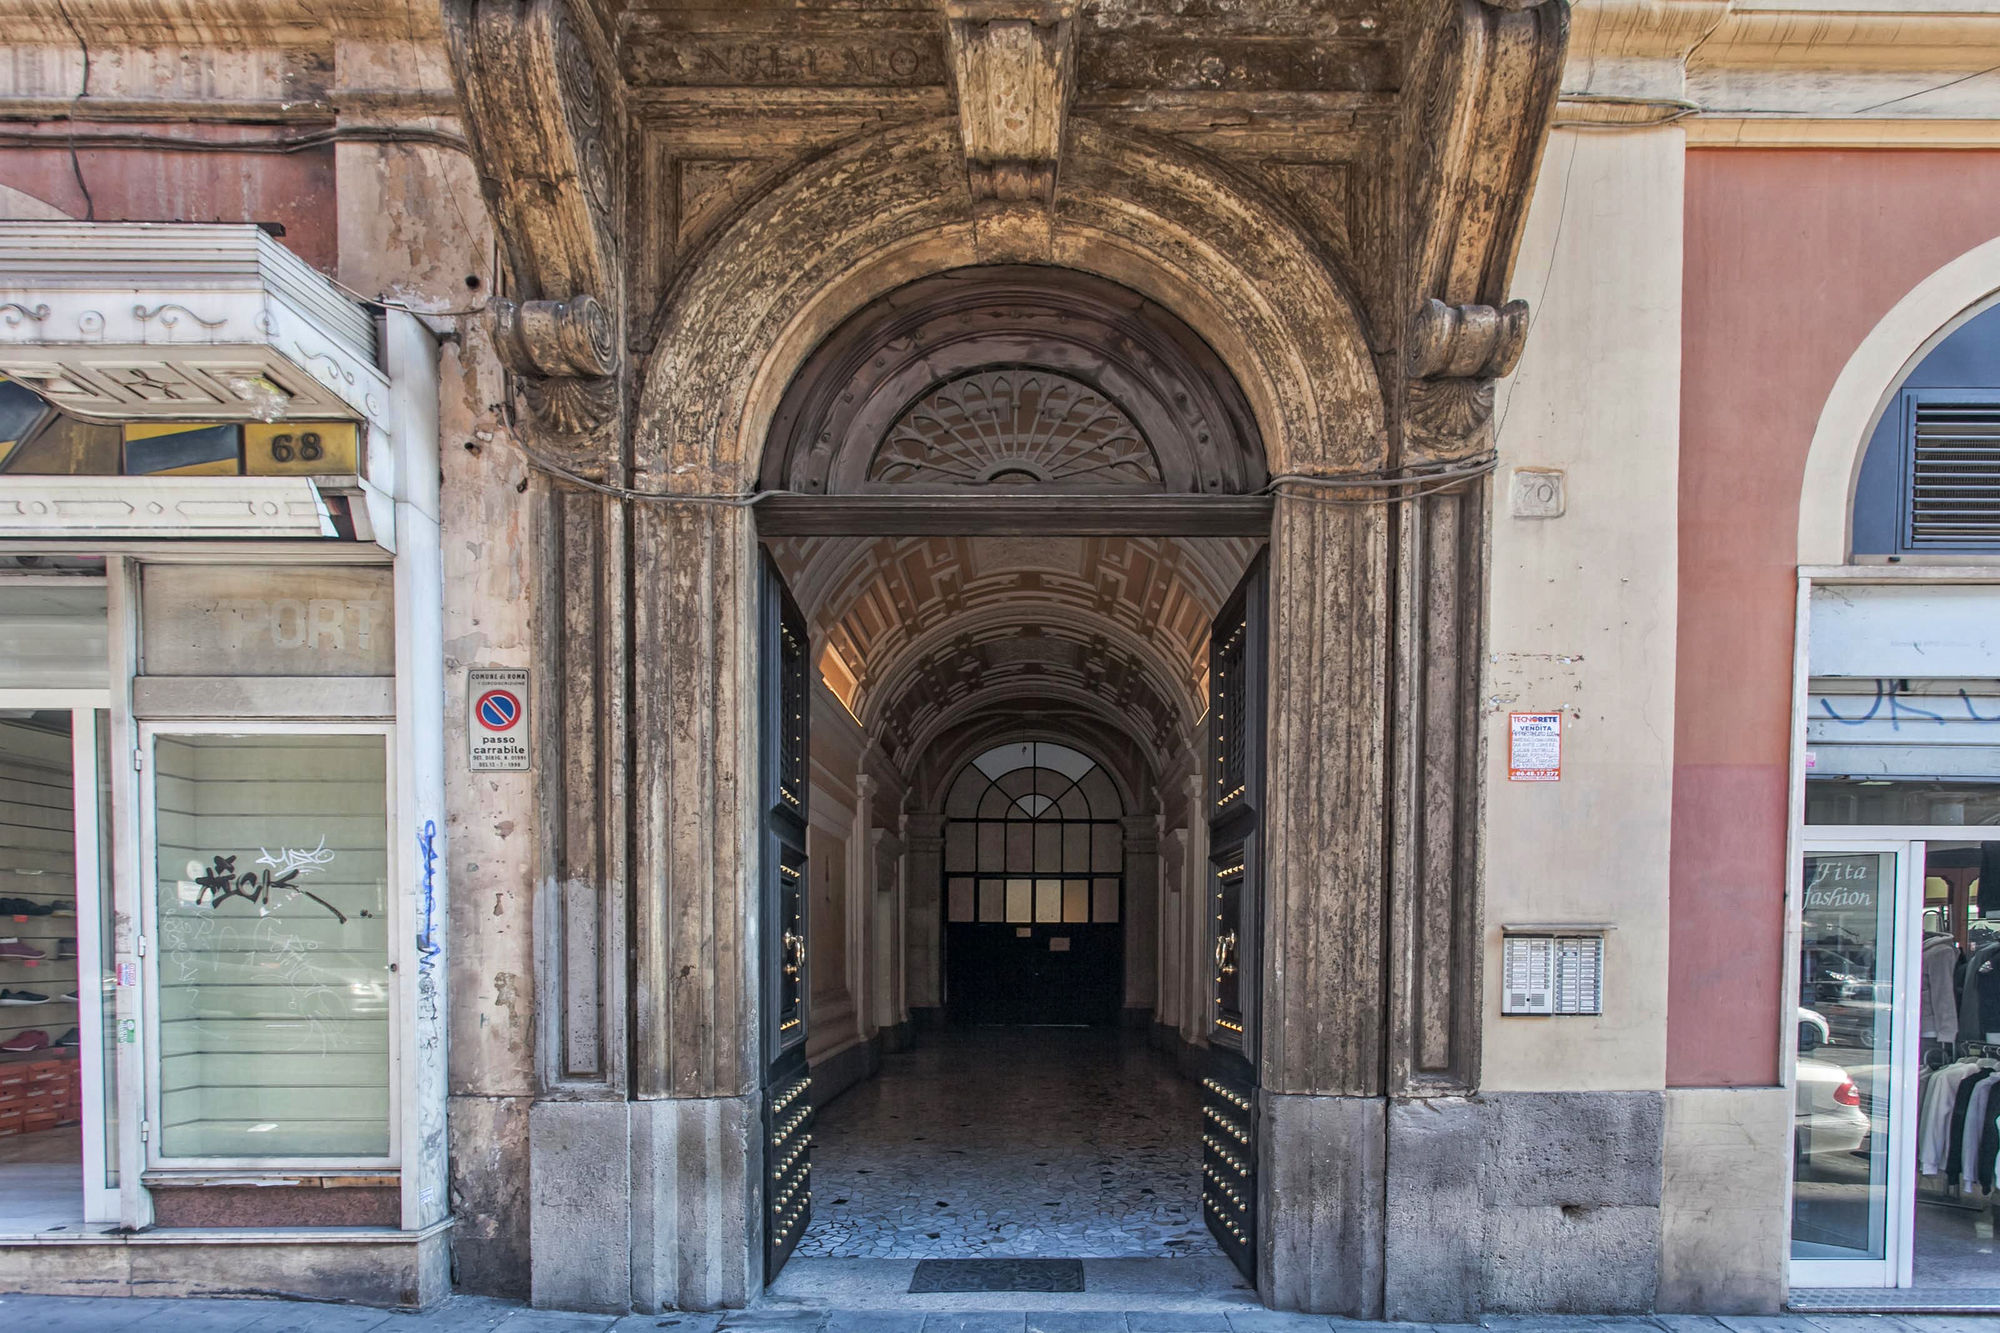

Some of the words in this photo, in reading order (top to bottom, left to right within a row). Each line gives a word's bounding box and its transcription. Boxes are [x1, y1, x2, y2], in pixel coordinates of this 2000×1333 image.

[271, 432, 324, 463] 68
[1522, 483, 1554, 503] 70
[473, 745, 525, 754] carrabile
[482, 736, 515, 745] passo
[1815, 862, 1867, 885] Fita
[1801, 886, 1873, 913] fashion
